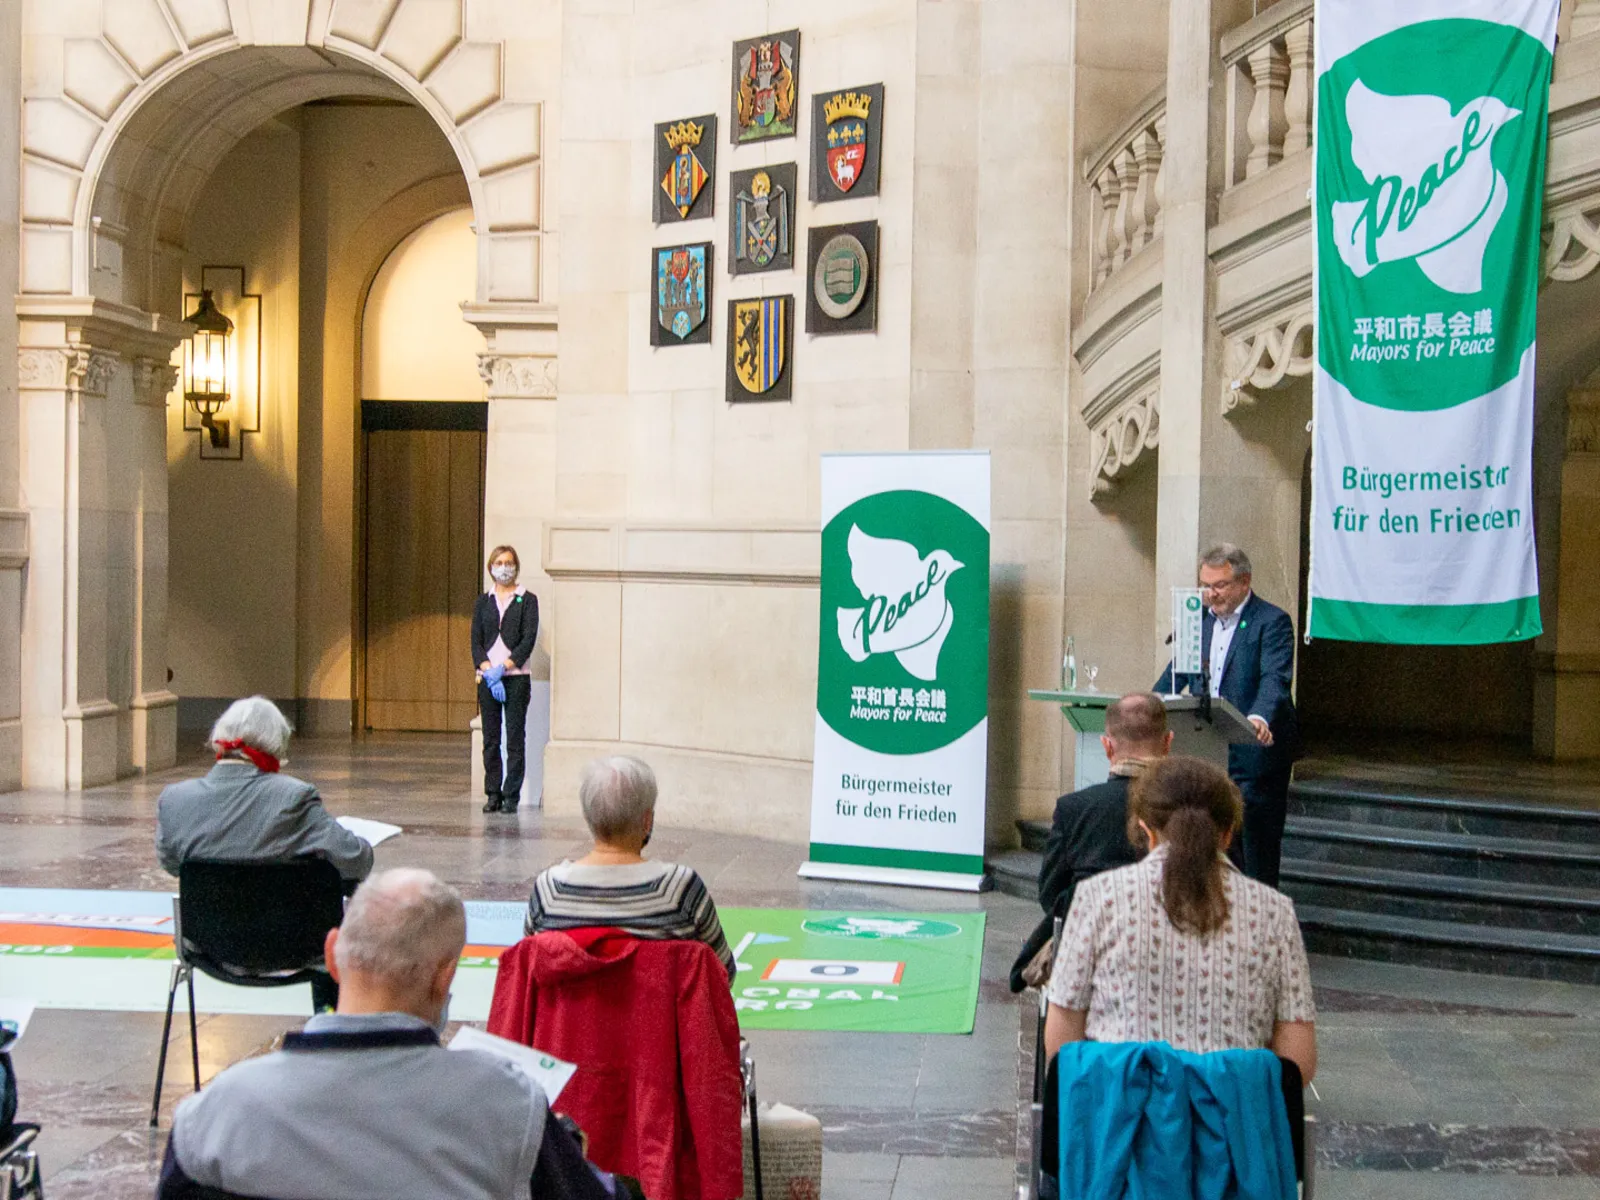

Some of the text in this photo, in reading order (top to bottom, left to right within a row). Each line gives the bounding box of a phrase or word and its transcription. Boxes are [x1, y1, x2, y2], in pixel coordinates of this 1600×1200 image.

[1352, 110, 1494, 266] Peace
[1353, 308, 1493, 343] 平和市長会議
[1350, 336, 1495, 363] Mayors for Peace
[1342, 464, 1510, 499] Bürgermeistr
[1332, 505, 1370, 532] für
[1379, 508, 1419, 533] den
[852, 559, 946, 654] Peace
[850, 704, 947, 723] Mayors for Peace
[841, 773, 953, 797] Bürgermeister
[836, 799, 957, 824] für den Frieden
